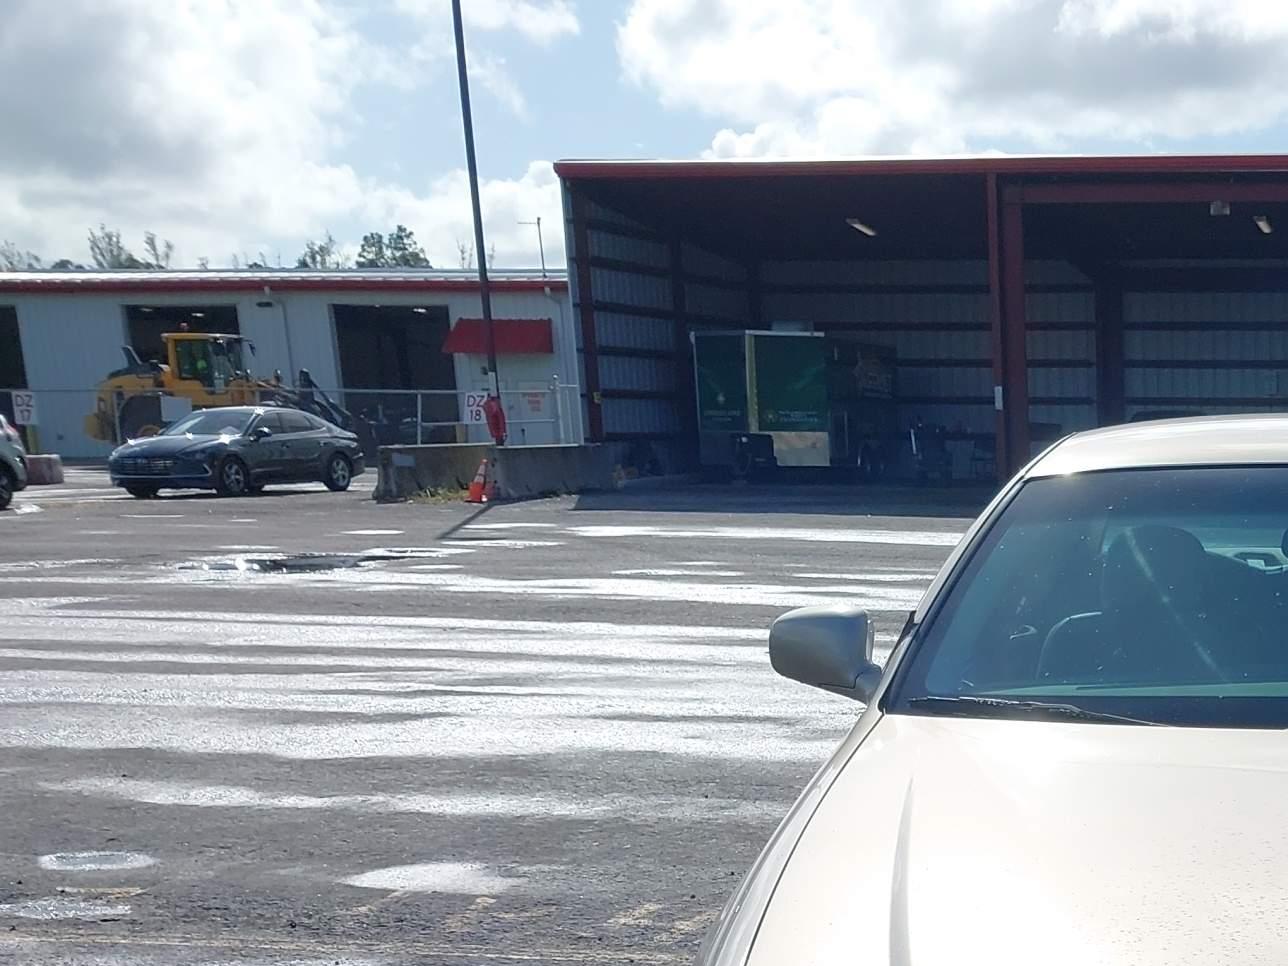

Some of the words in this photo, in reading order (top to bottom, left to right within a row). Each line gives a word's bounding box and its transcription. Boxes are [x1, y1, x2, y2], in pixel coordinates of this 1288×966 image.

[15, 394, 34, 408] DZ
[467, 395, 486, 407] DZ
[20, 409, 31, 421] 17
[470, 409, 482, 421] 18
